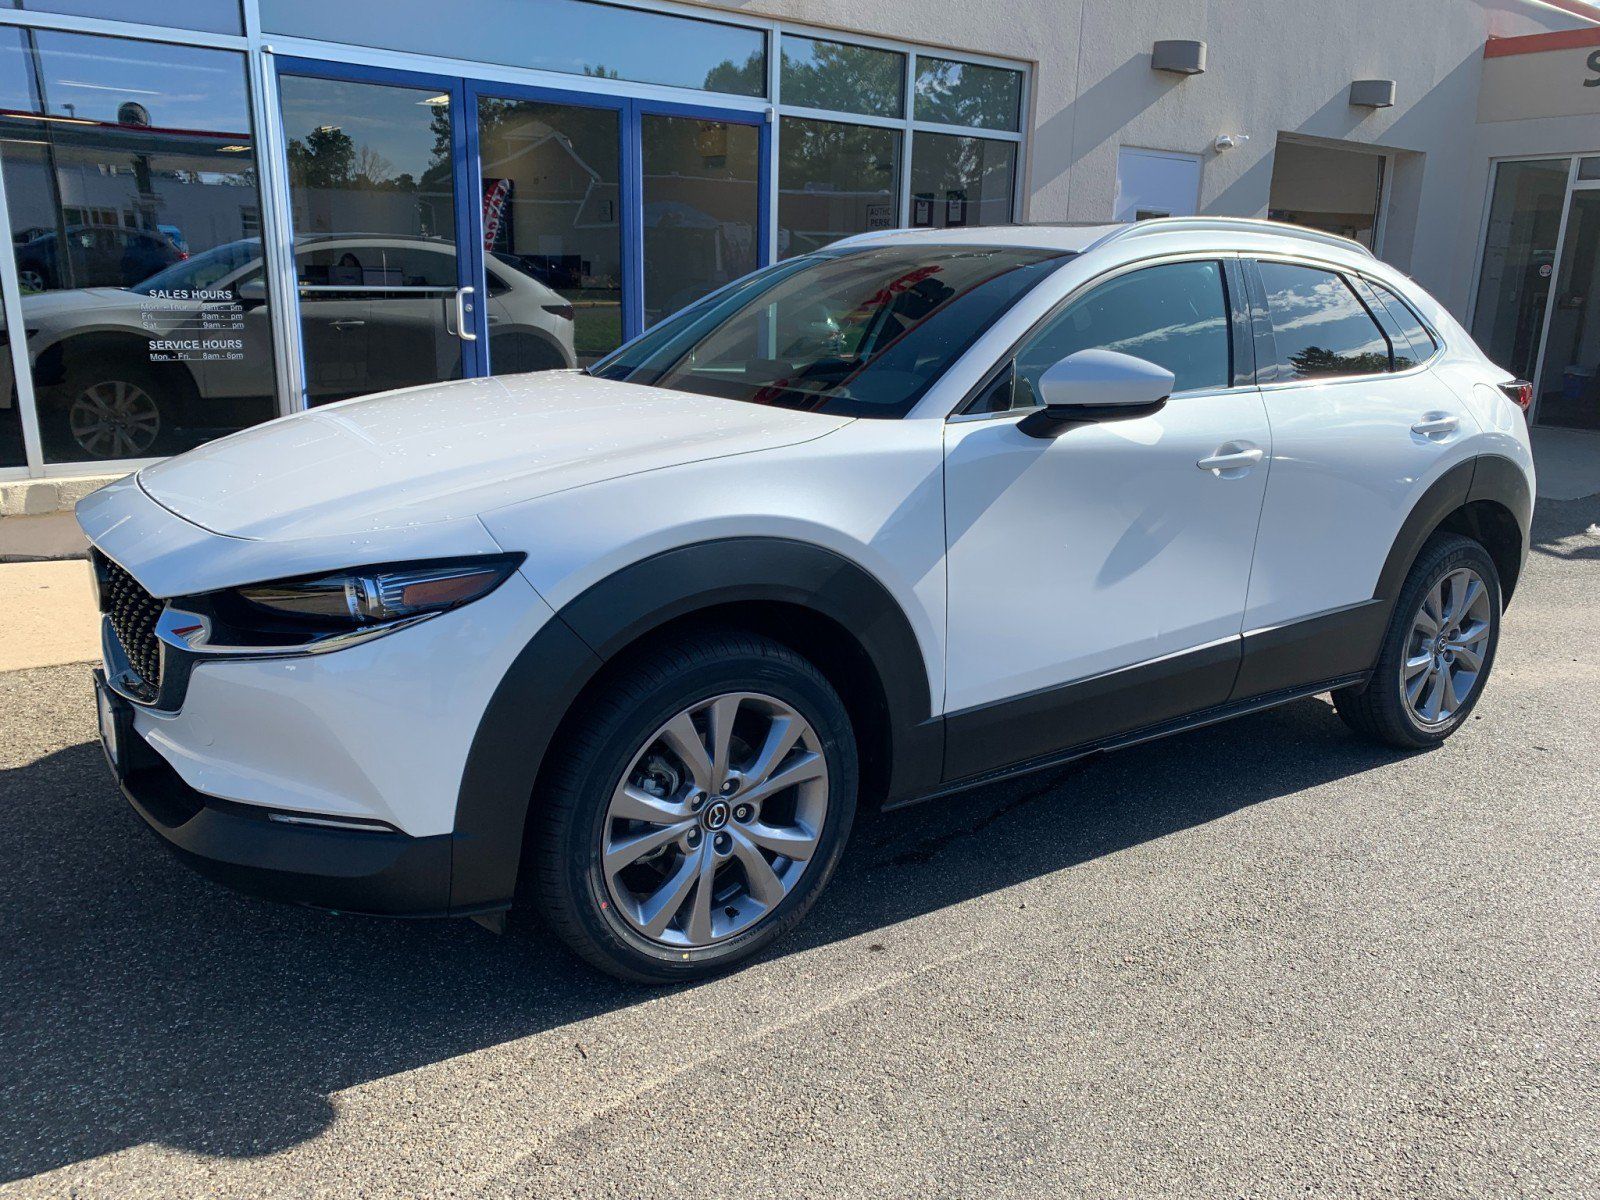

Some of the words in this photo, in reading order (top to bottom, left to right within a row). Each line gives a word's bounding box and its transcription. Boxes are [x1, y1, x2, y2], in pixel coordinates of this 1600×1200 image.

[149, 289, 188, 299] SALES
[191, 290, 232, 299] HOURS
[201, 312, 219, 320] 9am
[203, 321, 220, 329] 9am
[149, 340, 199, 349] SERVICE
[202, 339, 242, 348] HOURS
[202, 352, 220, 360] 8am
[226, 351, 244, 360] 6pm
